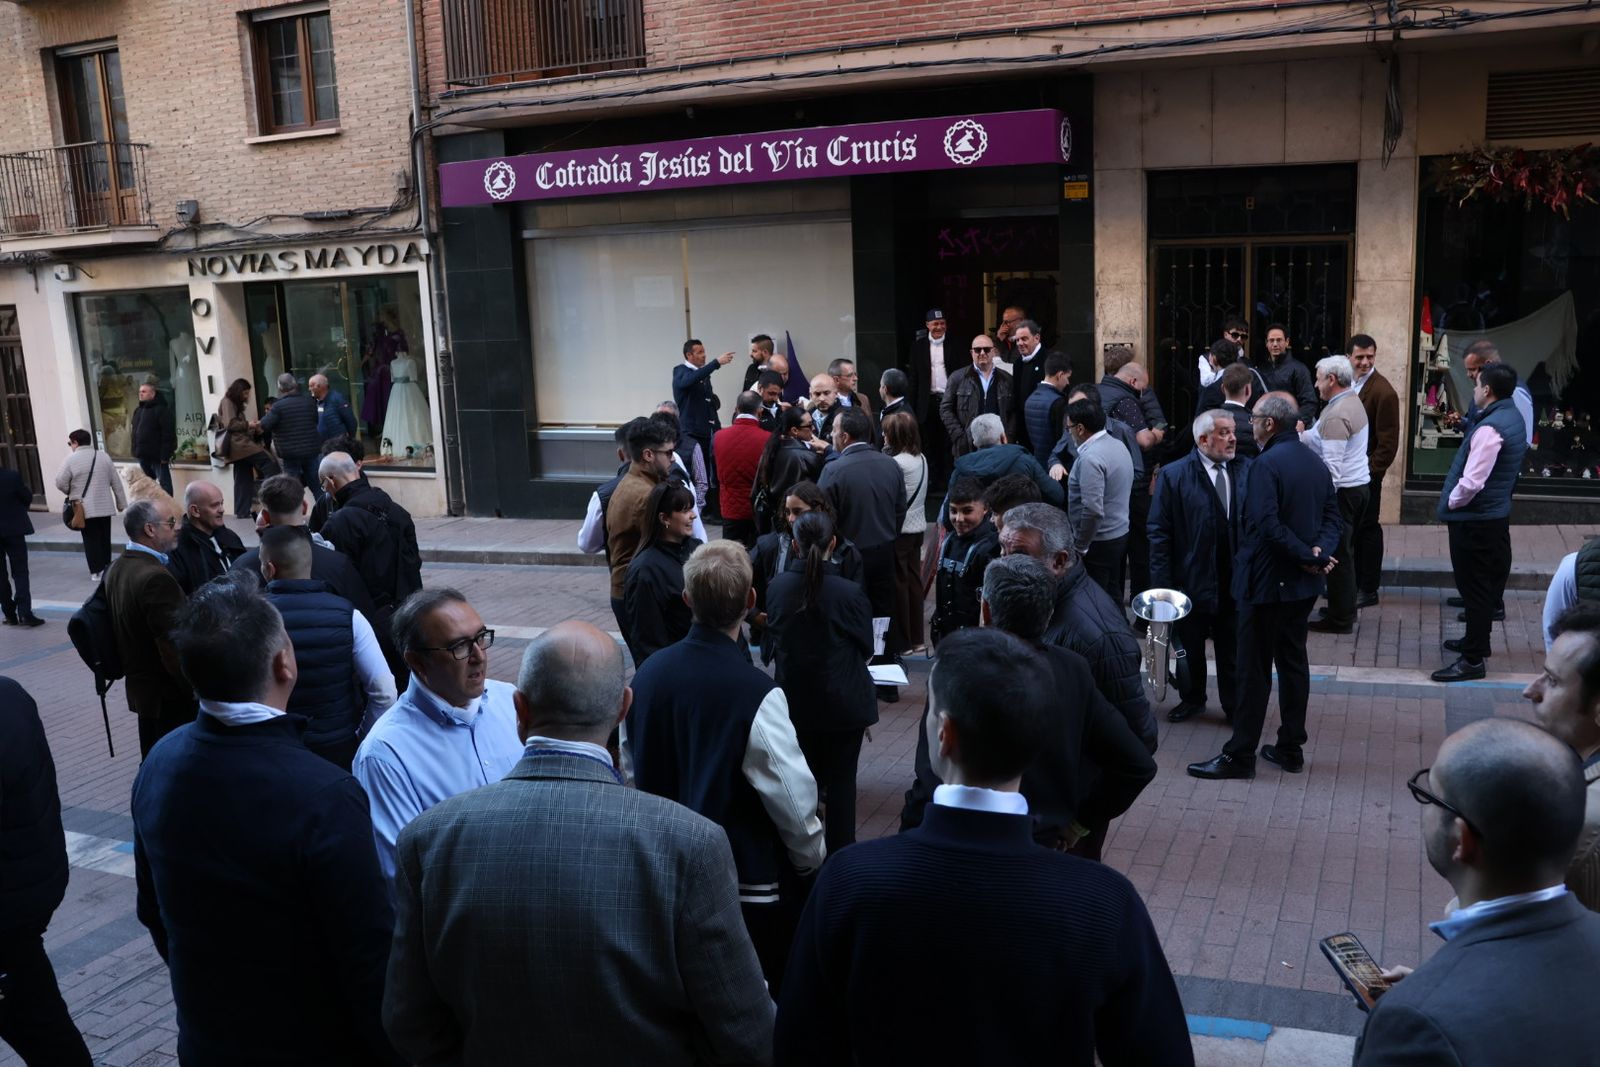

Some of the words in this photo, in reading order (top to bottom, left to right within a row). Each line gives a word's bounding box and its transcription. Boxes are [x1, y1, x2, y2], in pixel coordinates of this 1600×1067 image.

[535, 153, 633, 190] Cofradía
[638, 146, 712, 186] Jesús
[718, 143, 754, 175] del
[760, 136, 819, 173] Vía
[187, 250, 299, 277] NOVIAS
[303, 242, 425, 270] MAYDA
